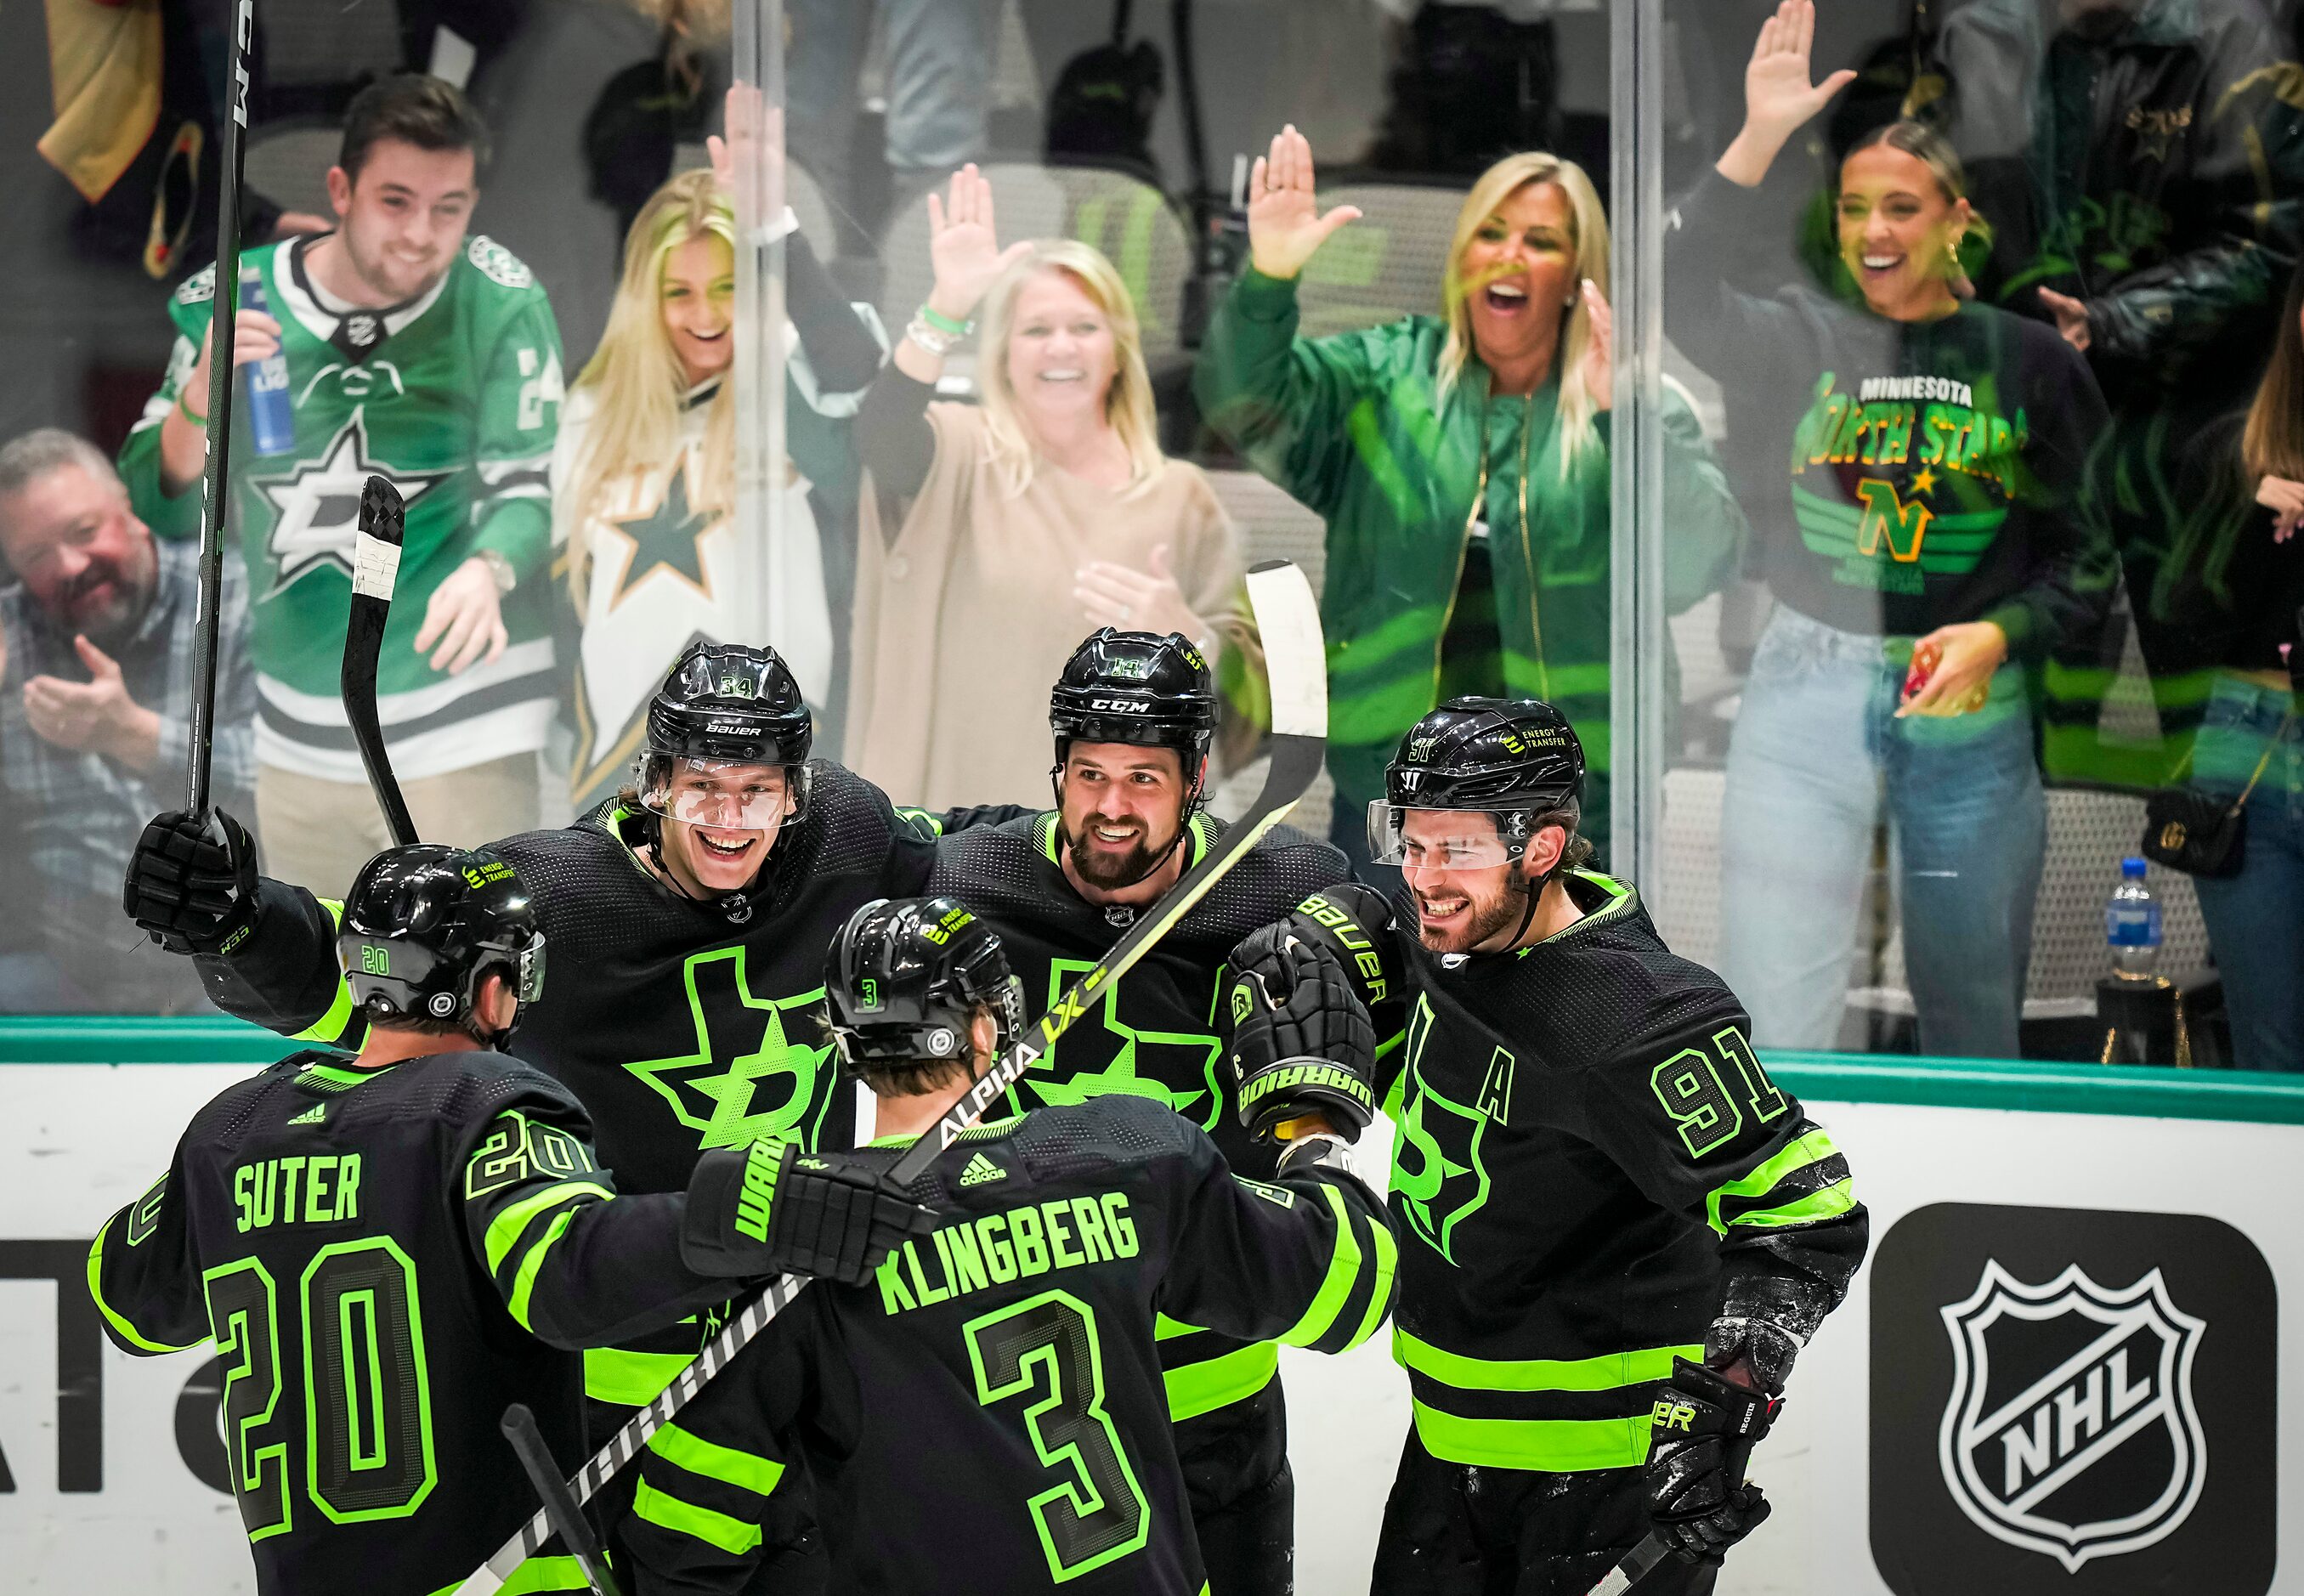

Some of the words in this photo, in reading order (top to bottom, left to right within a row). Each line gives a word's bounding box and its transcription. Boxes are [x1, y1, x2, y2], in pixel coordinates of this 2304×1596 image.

[1860, 376, 1973, 408] MINNESOTA
[1112, 657, 1140, 678] 14
[720, 676, 755, 700] 34
[1090, 699, 1151, 713] CCM
[705, 723, 762, 736] BAUER
[1522, 727, 1556, 739] ENERGY
[1526, 738, 1566, 748] TRANSFER
[1408, 738, 1436, 762] 91
[479, 862, 505, 874] ENERGY
[221, 927, 249, 954] CCM
[1296, 894, 1388, 1006] BAUER
[361, 945, 390, 976] 20
[862, 979, 877, 1009] 3
[940, 1043, 1042, 1151] ALPHA
[1238, 1066, 1373, 1113] WARRIOR
[1475, 1044, 1515, 1127] A
[1650, 1026, 1788, 1159] 91
[287, 1115, 326, 1125] adidas
[465, 1109, 594, 1201] 20
[234, 1153, 361, 1233] SUTER
[960, 1169, 1007, 1186] adidas
[875, 1191, 1140, 1316] KLINGBERG
[202, 1235, 439, 1544] 20
[1739, 1401, 1757, 1434] SEGUIN
[1999, 1348, 2151, 1497] NHL
[962, 1288, 1151, 1584] 3
